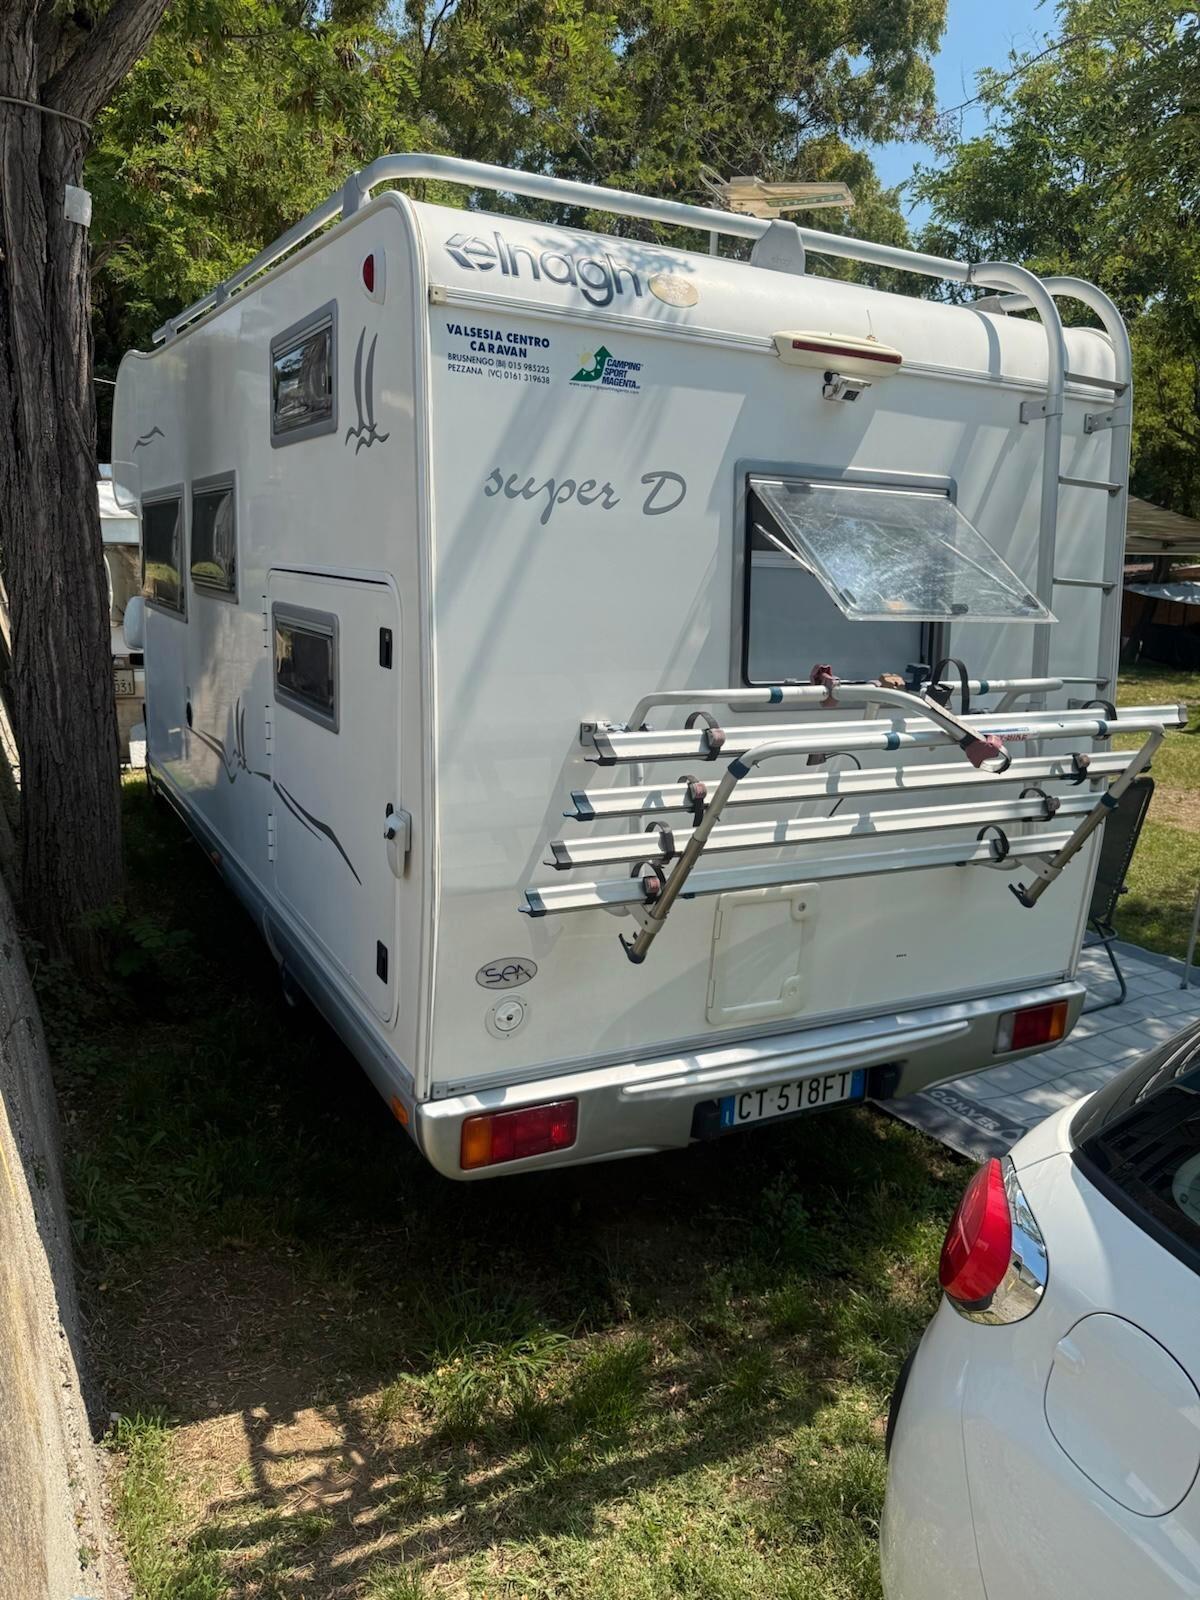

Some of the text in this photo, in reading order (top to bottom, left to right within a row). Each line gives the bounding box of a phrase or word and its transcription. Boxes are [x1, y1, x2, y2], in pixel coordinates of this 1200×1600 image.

[446, 323, 550, 349] VALSESIA CENTRO
[470, 340, 528, 359] CARAVAN
[447, 352, 495, 367] BRUSNENGO
[508, 361, 522, 371] 015
[523, 363, 550, 375] 985225
[447, 363, 551, 385] PEZZANA (VC) 0161 319638
[603, 367, 628, 379] SPORT
[606, 358, 641, 372] CAMPING
[601, 376, 636, 390] MAGENTA
[484, 467, 687, 525] super D
[739, 1072, 850, 1120] CT 518FT
